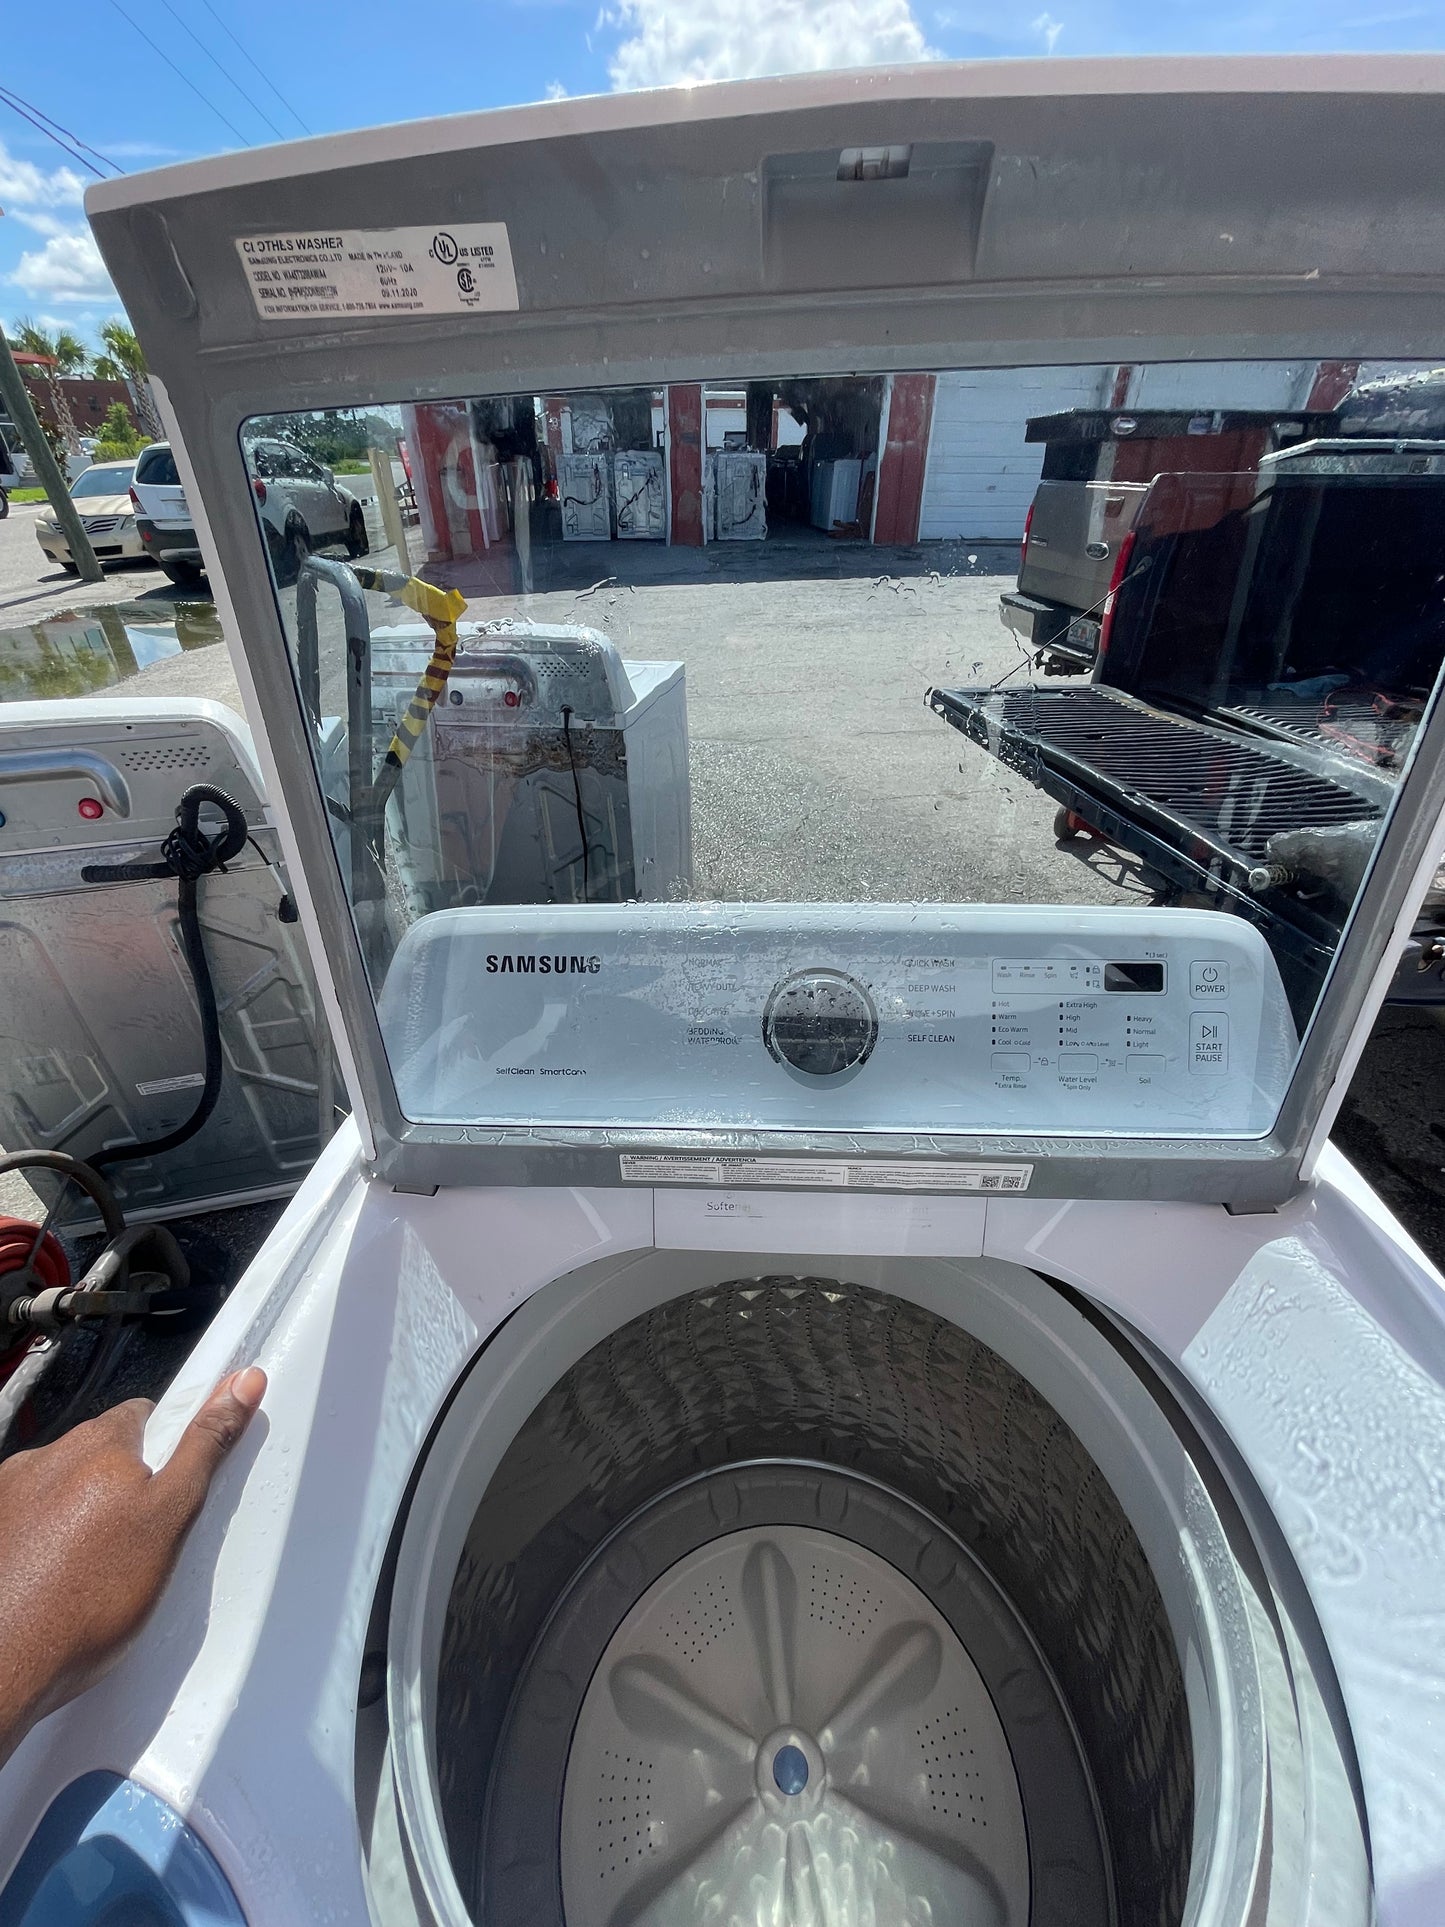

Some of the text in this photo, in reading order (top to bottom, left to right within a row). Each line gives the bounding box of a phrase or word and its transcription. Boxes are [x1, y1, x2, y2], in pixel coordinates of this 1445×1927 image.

[296, 237, 343, 250] WASHER
[470, 246, 494, 257] LISTED
[486, 955, 600, 974] SAMSUNG
[908, 985, 956, 993] DEEP WASH
[1195, 985, 1225, 993] POWER
[1083, 1002, 1097, 1010] High
[1066, 1027, 1078, 1035] Mid
[908, 1034, 955, 1043] SELF CLEAN
[1133, 1041, 1149, 1049] Light
[1195, 1043, 1222, 1051] START
[1195, 1054, 1222, 1062] PAUSE
[496, 1067, 535, 1076] SelfClean
[1139, 1077, 1151, 1085] Soil
